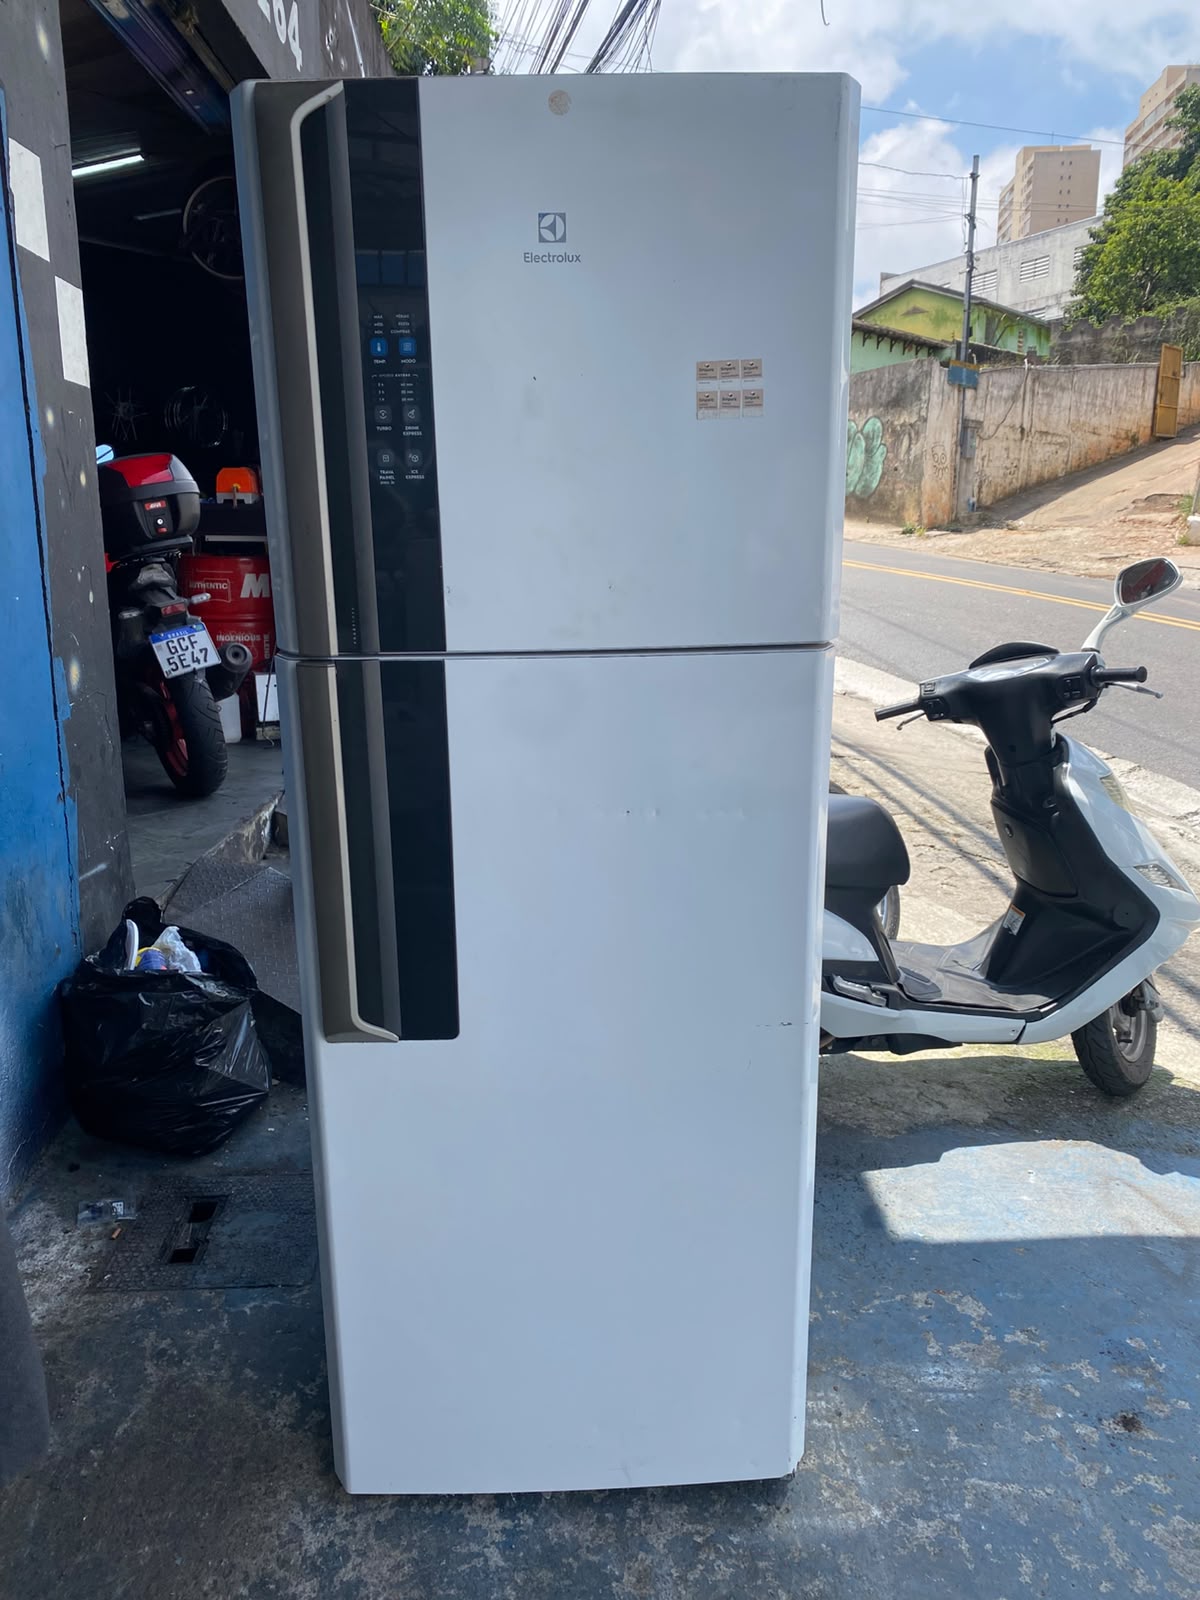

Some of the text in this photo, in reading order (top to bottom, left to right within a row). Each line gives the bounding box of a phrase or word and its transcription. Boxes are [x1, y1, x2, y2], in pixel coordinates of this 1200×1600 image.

[523, 252, 582, 263] Electrolux
[167, 630, 189, 639] BRASIL
[216, 633, 261, 642] INGENIOUS
[166, 634, 198, 655] GCF
[166, 647, 208, 672] 5E47
